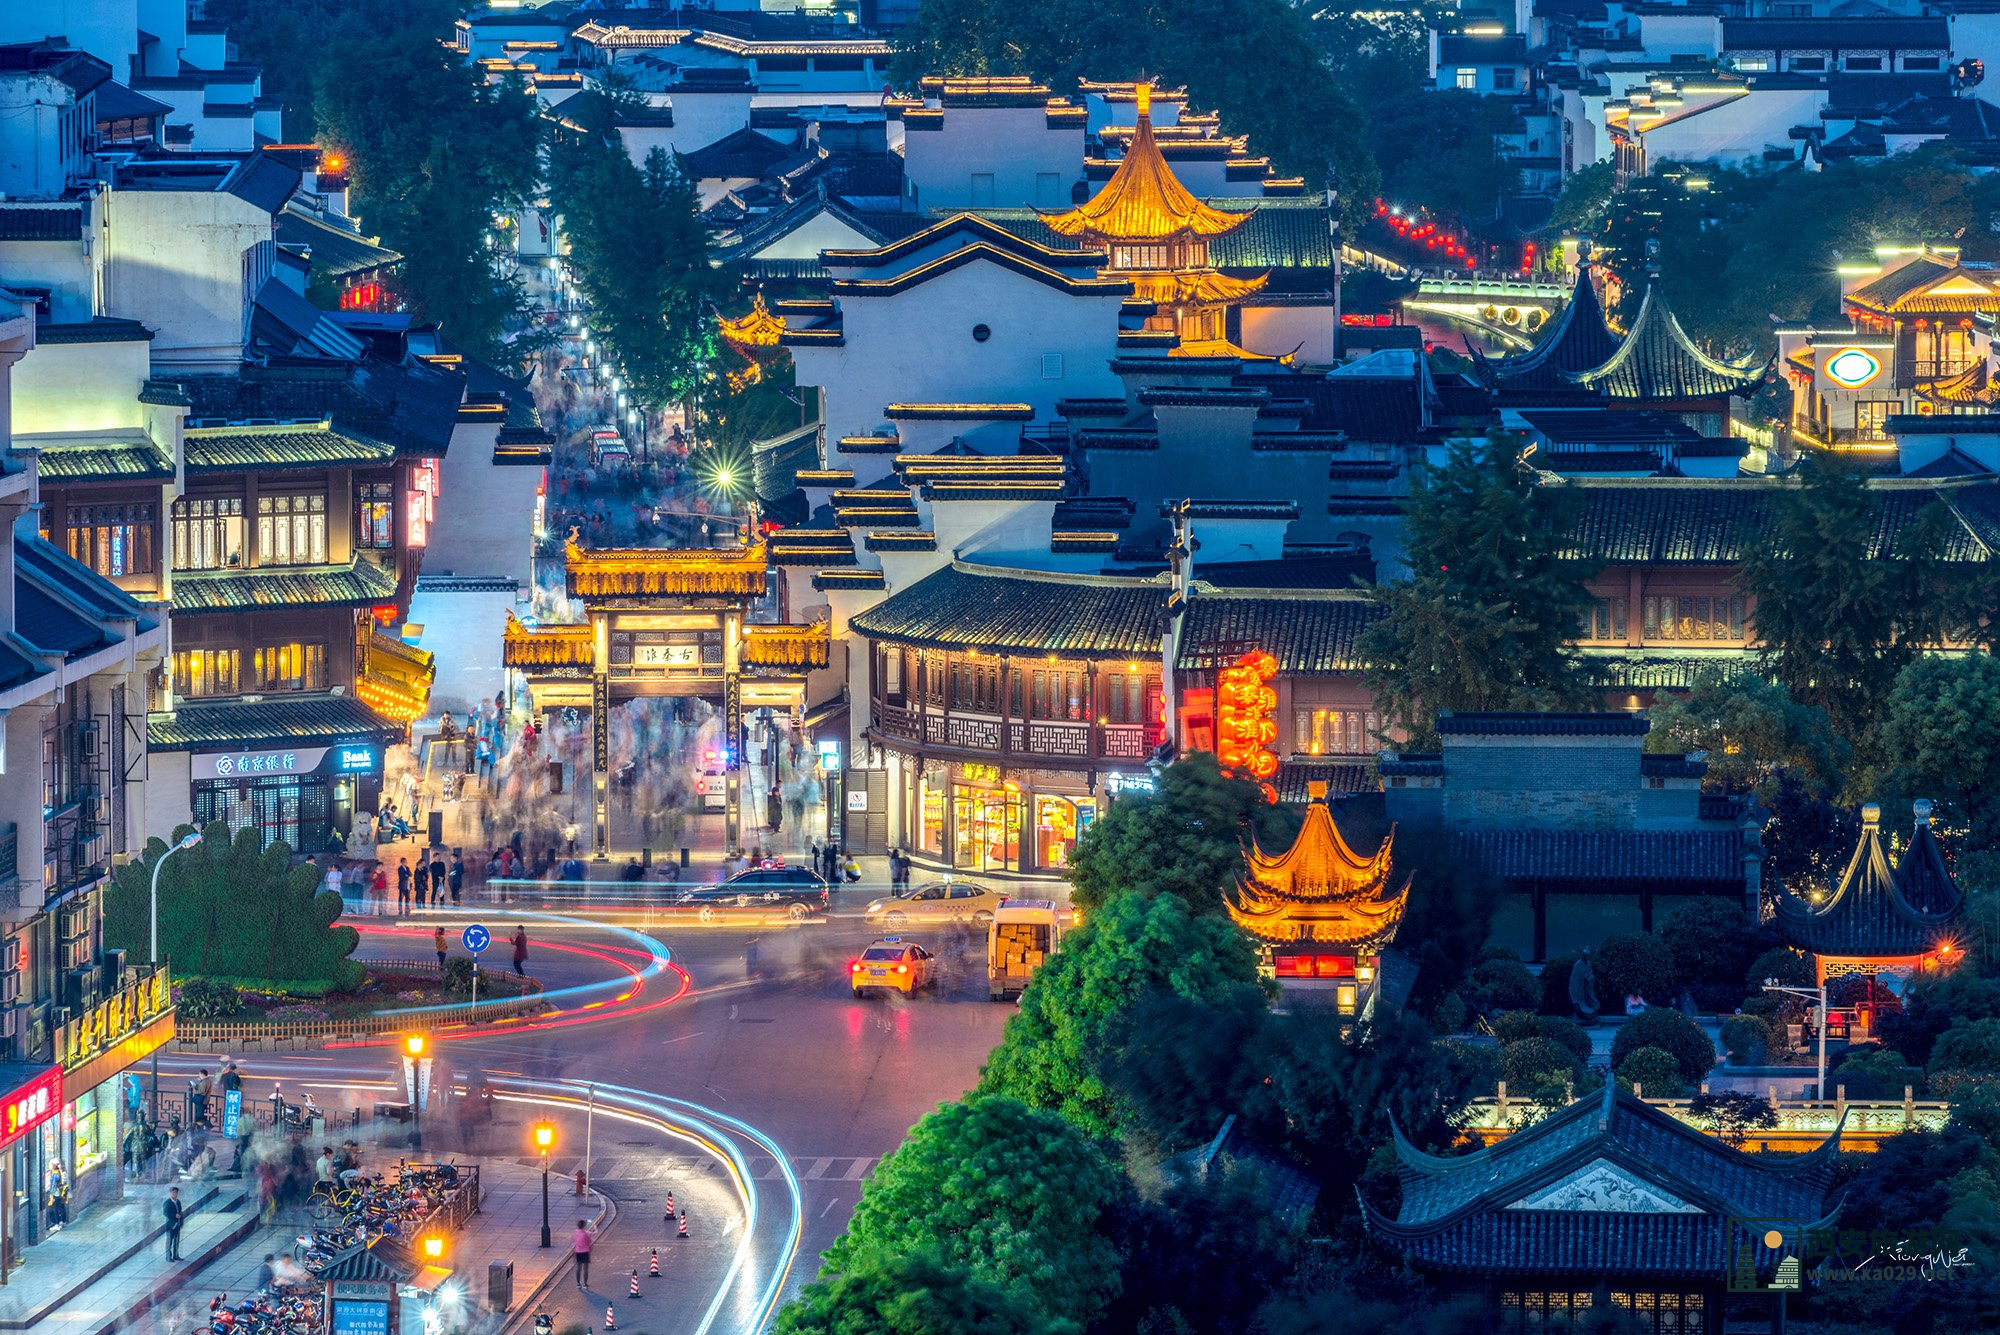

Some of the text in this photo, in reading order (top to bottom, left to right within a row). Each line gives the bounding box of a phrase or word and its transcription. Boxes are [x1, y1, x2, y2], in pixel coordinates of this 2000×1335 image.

[646, 647, 693, 662] 古秦淮
[237, 753, 296, 772] 南京银行
[342, 750, 371, 762] Bank
[225, 1093, 239, 1136] 禁止停车
[337, 1283, 388, 1296] 便民服务亭
